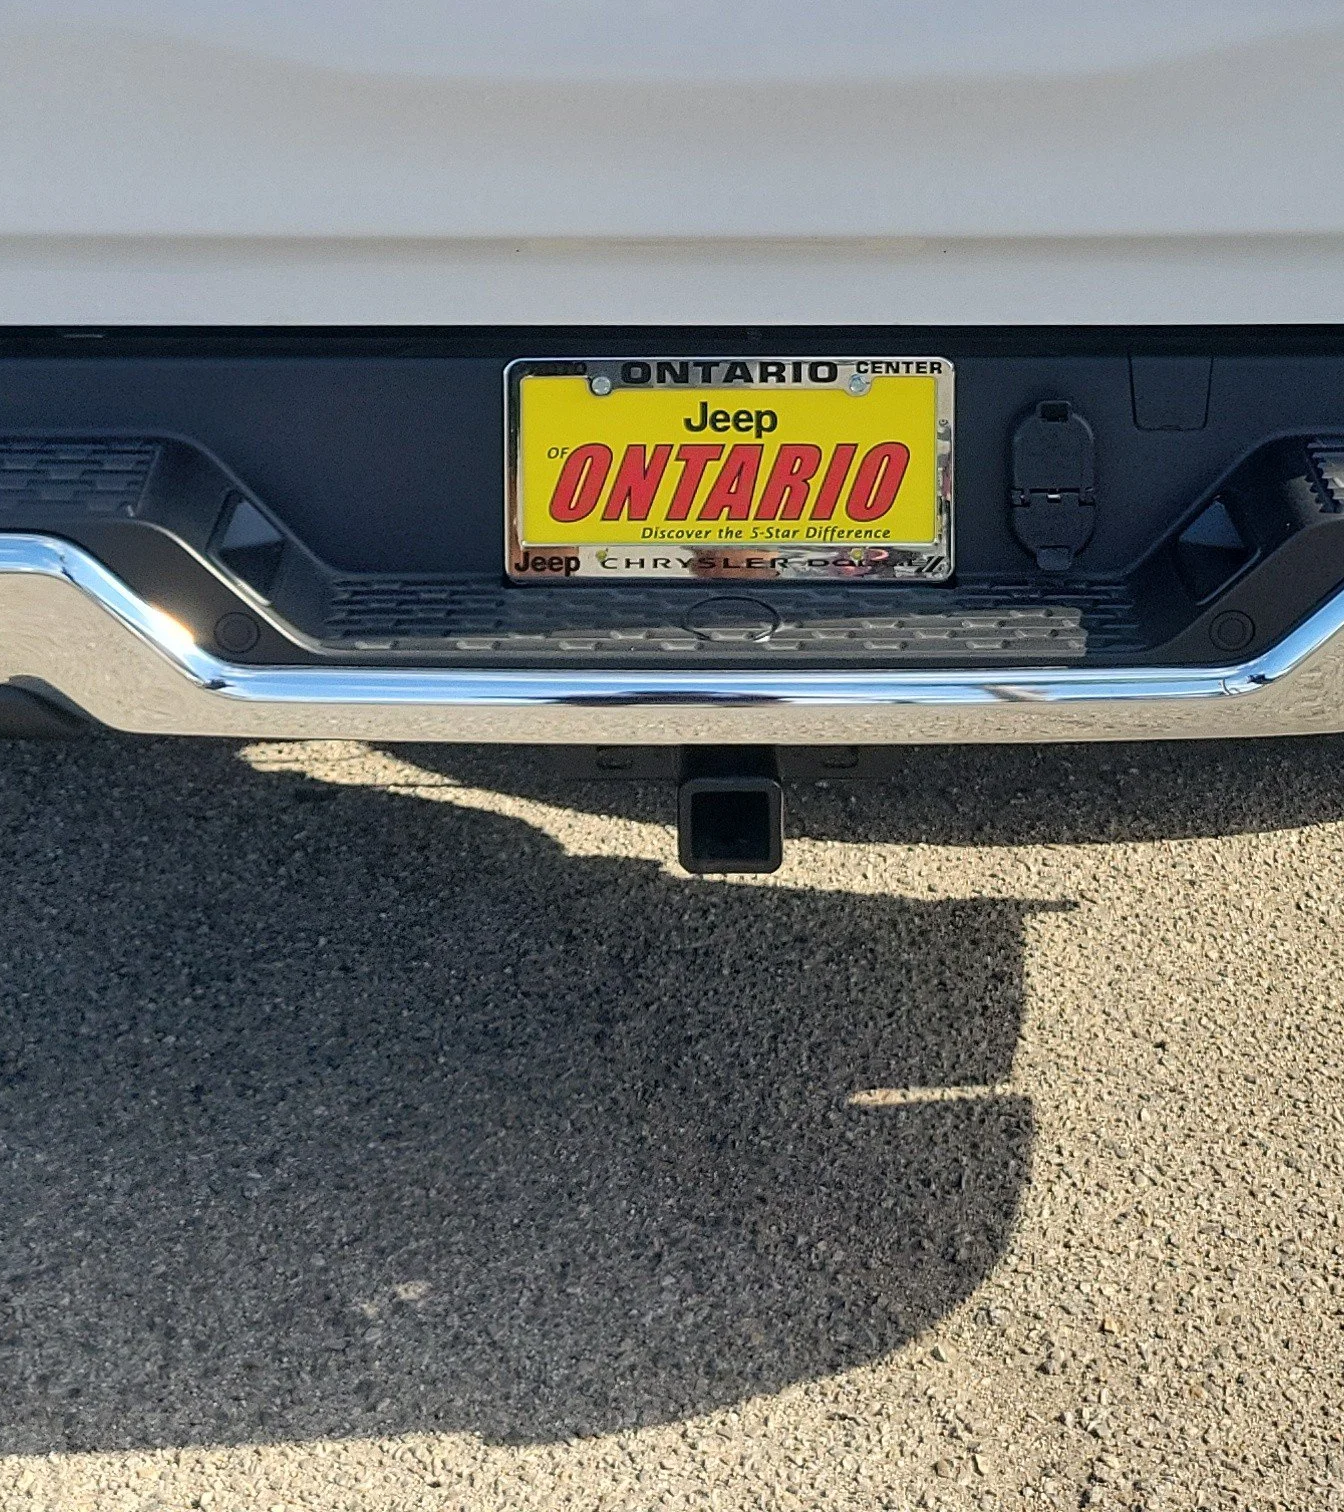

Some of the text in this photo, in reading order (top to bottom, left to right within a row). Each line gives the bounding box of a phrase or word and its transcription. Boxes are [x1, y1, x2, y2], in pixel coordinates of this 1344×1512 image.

[621, 360, 943, 384] ONTARIO CENTER
[683, 401, 778, 439] Jeep
[547, 446, 569, 460] OF
[549, 441, 910, 522] ONTARIO
[641, 526, 891, 541] Discover the 5-Star Difference
[514, 551, 581, 577] Jeep
[601, 556, 788, 569] CHRYSLER
